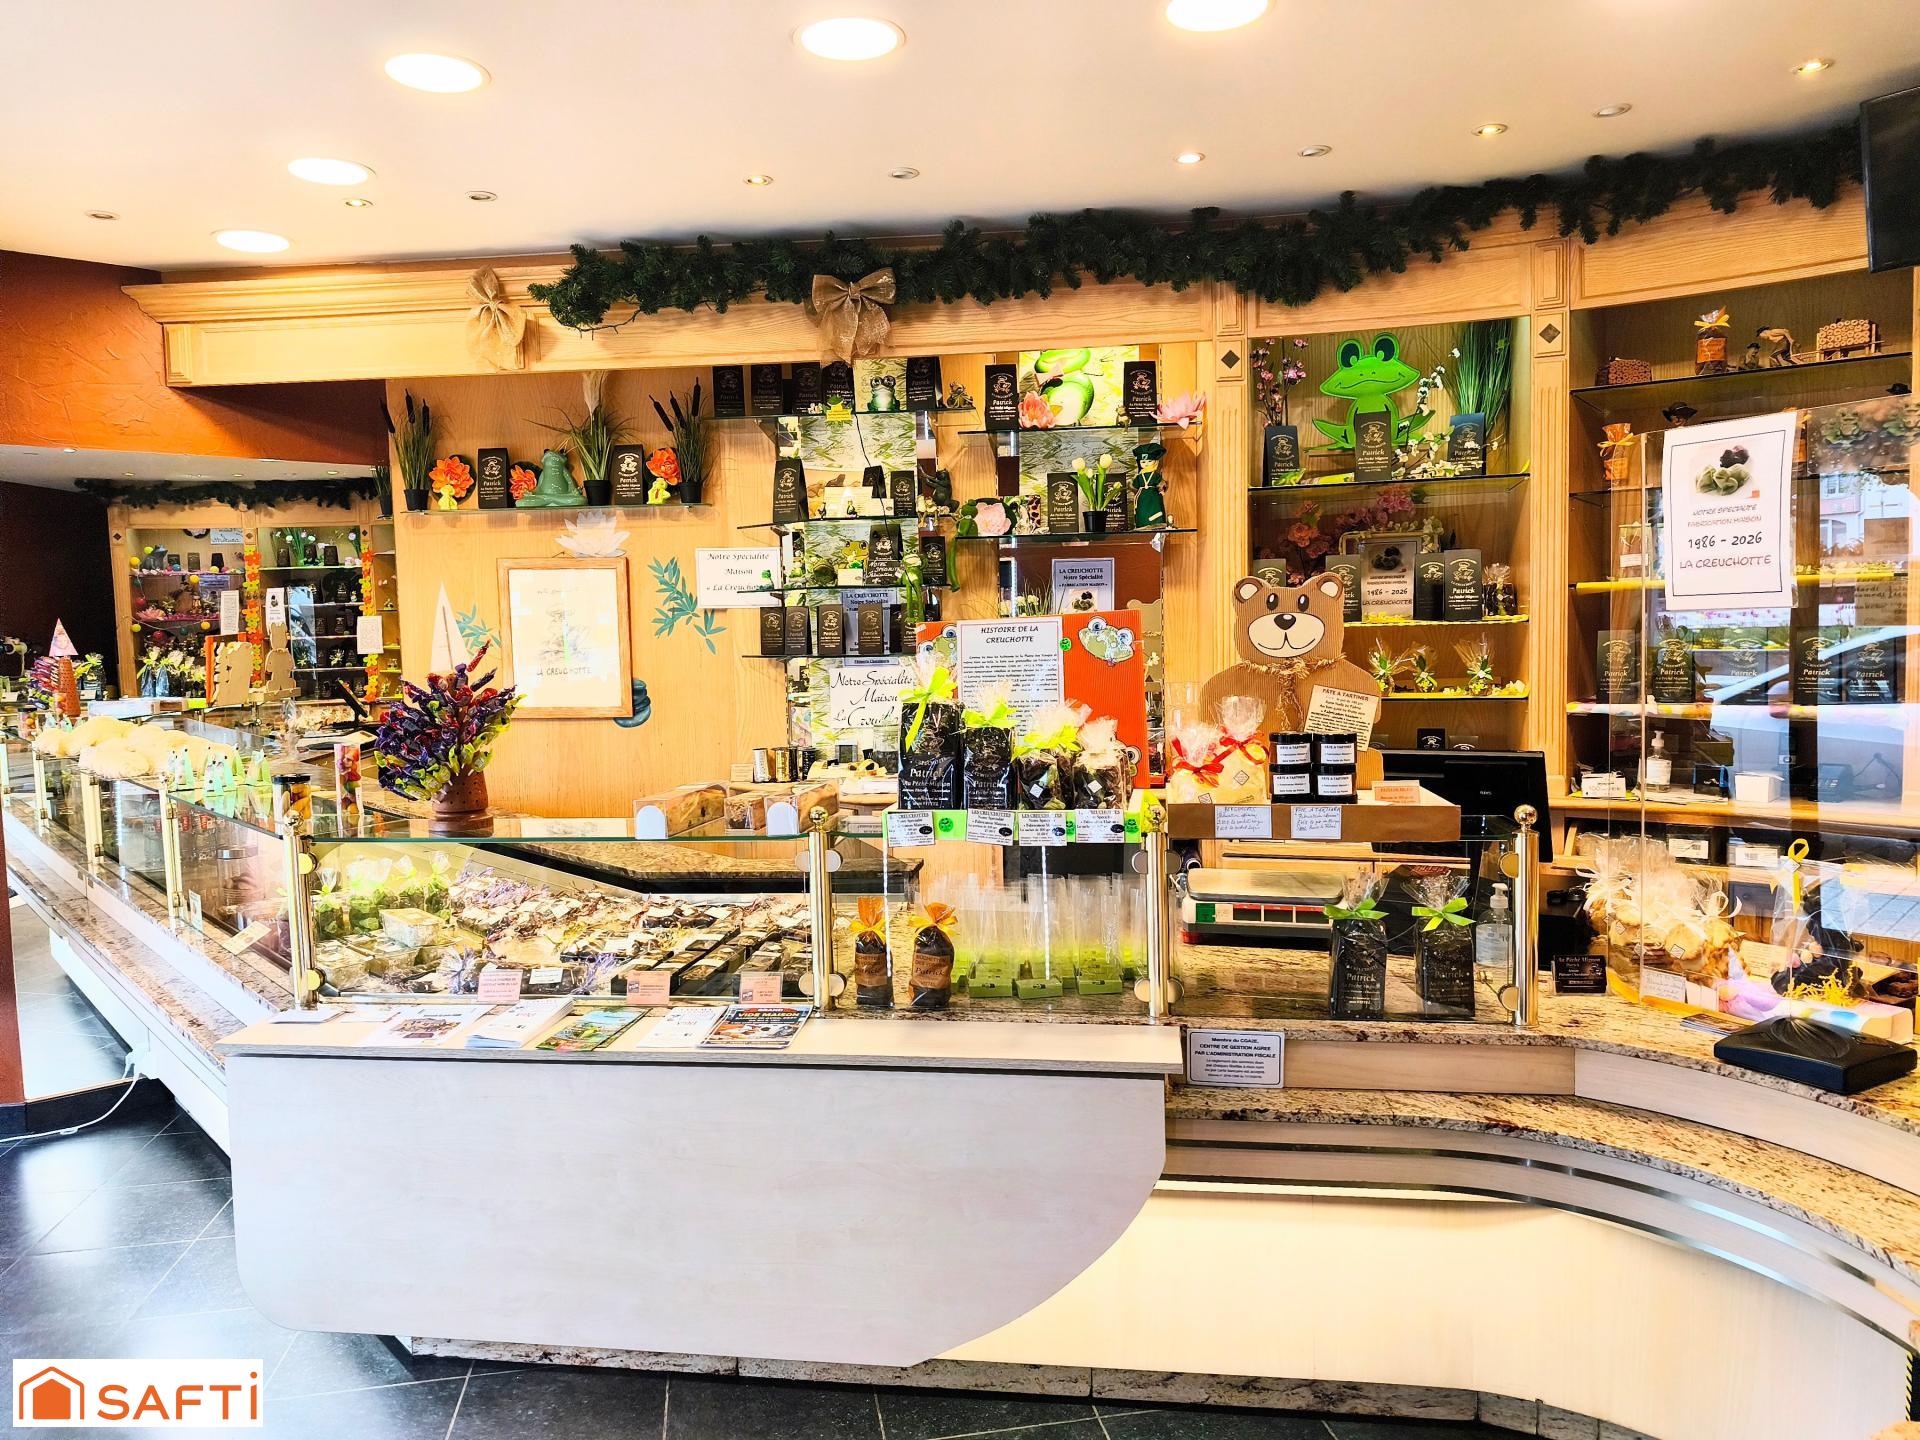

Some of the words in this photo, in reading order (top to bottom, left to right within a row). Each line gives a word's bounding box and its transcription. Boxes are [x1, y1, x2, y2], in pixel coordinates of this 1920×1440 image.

[1688, 535, 1716, 549] 1986
[1732, 531, 1762, 545] 2026
[1679, 560, 1693, 568] LA
[1695, 555, 1772, 568] CREUCHOTTE
[981, 626, 1016, 634] HISTOIRE
[1803, 668, 1831, 676] Patrick
[831, 672, 862, 688] Notre
[850, 688, 898, 705] Maison
[1342, 693, 1369, 701] TARTINER
[910, 768, 944, 778] Patrick
[916, 967, 945, 976] Patrick
[1435, 970, 1464, 978] Patrick
[1346, 973, 1376, 981] Patrick
